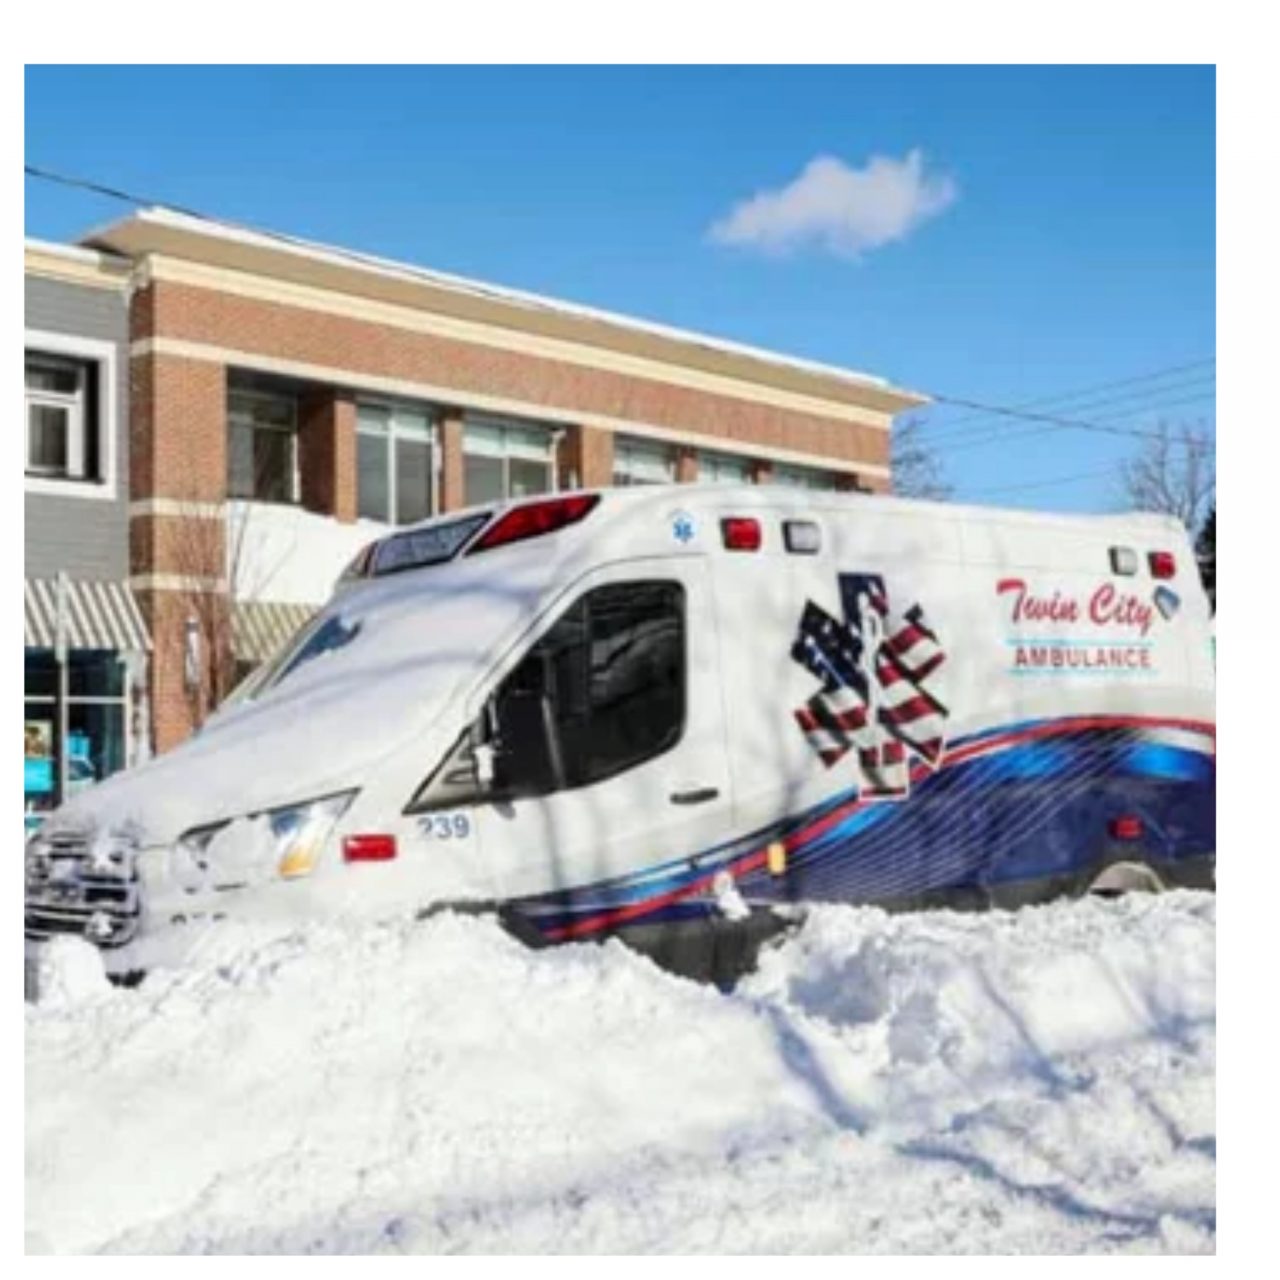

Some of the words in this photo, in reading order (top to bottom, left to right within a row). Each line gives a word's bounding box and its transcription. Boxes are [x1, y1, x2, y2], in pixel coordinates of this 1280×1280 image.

[996, 578, 1078, 625] Twin
[1088, 582, 1153, 637] City
[1014, 645, 1152, 669] AMBULANCE
